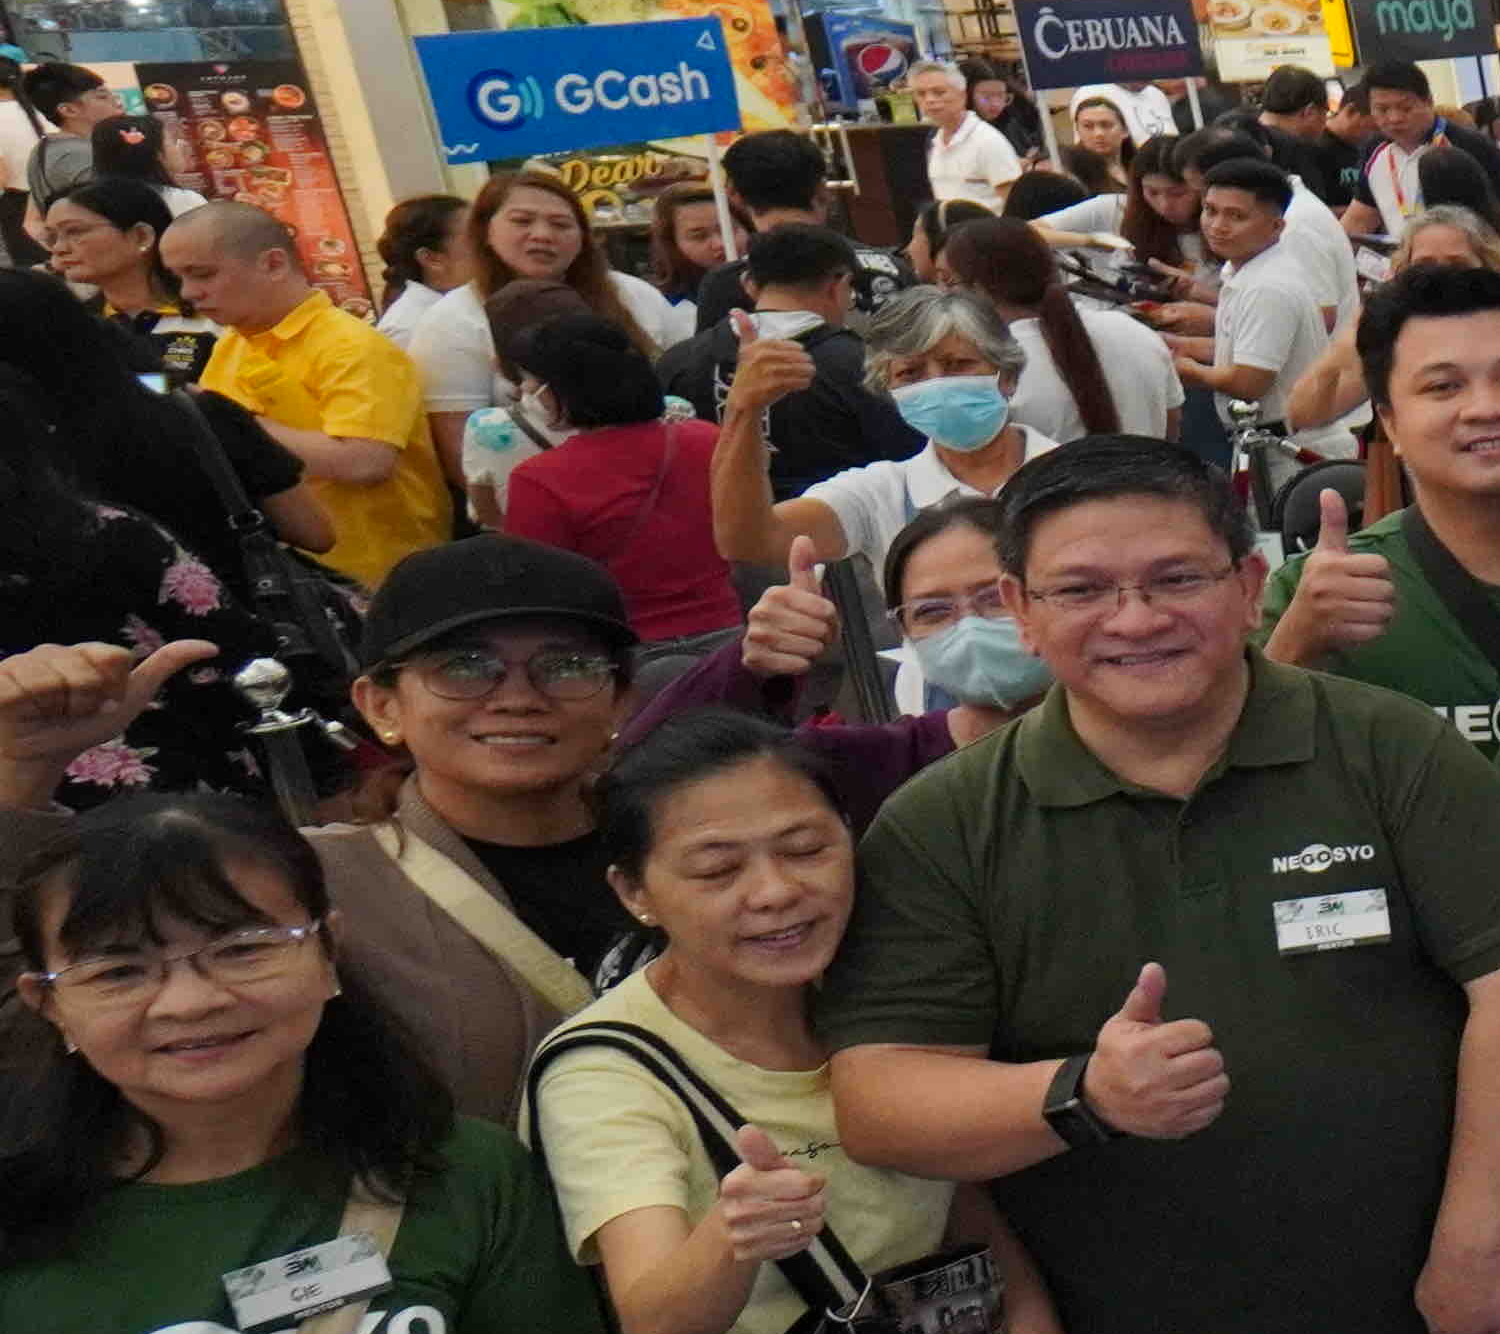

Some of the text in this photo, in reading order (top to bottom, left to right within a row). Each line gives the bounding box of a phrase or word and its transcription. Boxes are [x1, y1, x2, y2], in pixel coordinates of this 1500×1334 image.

[1034, 6, 1188, 60] CEBUANA
[554, 61, 711, 115] GCash
[1272, 844, 1375, 873] NEGOSYO
